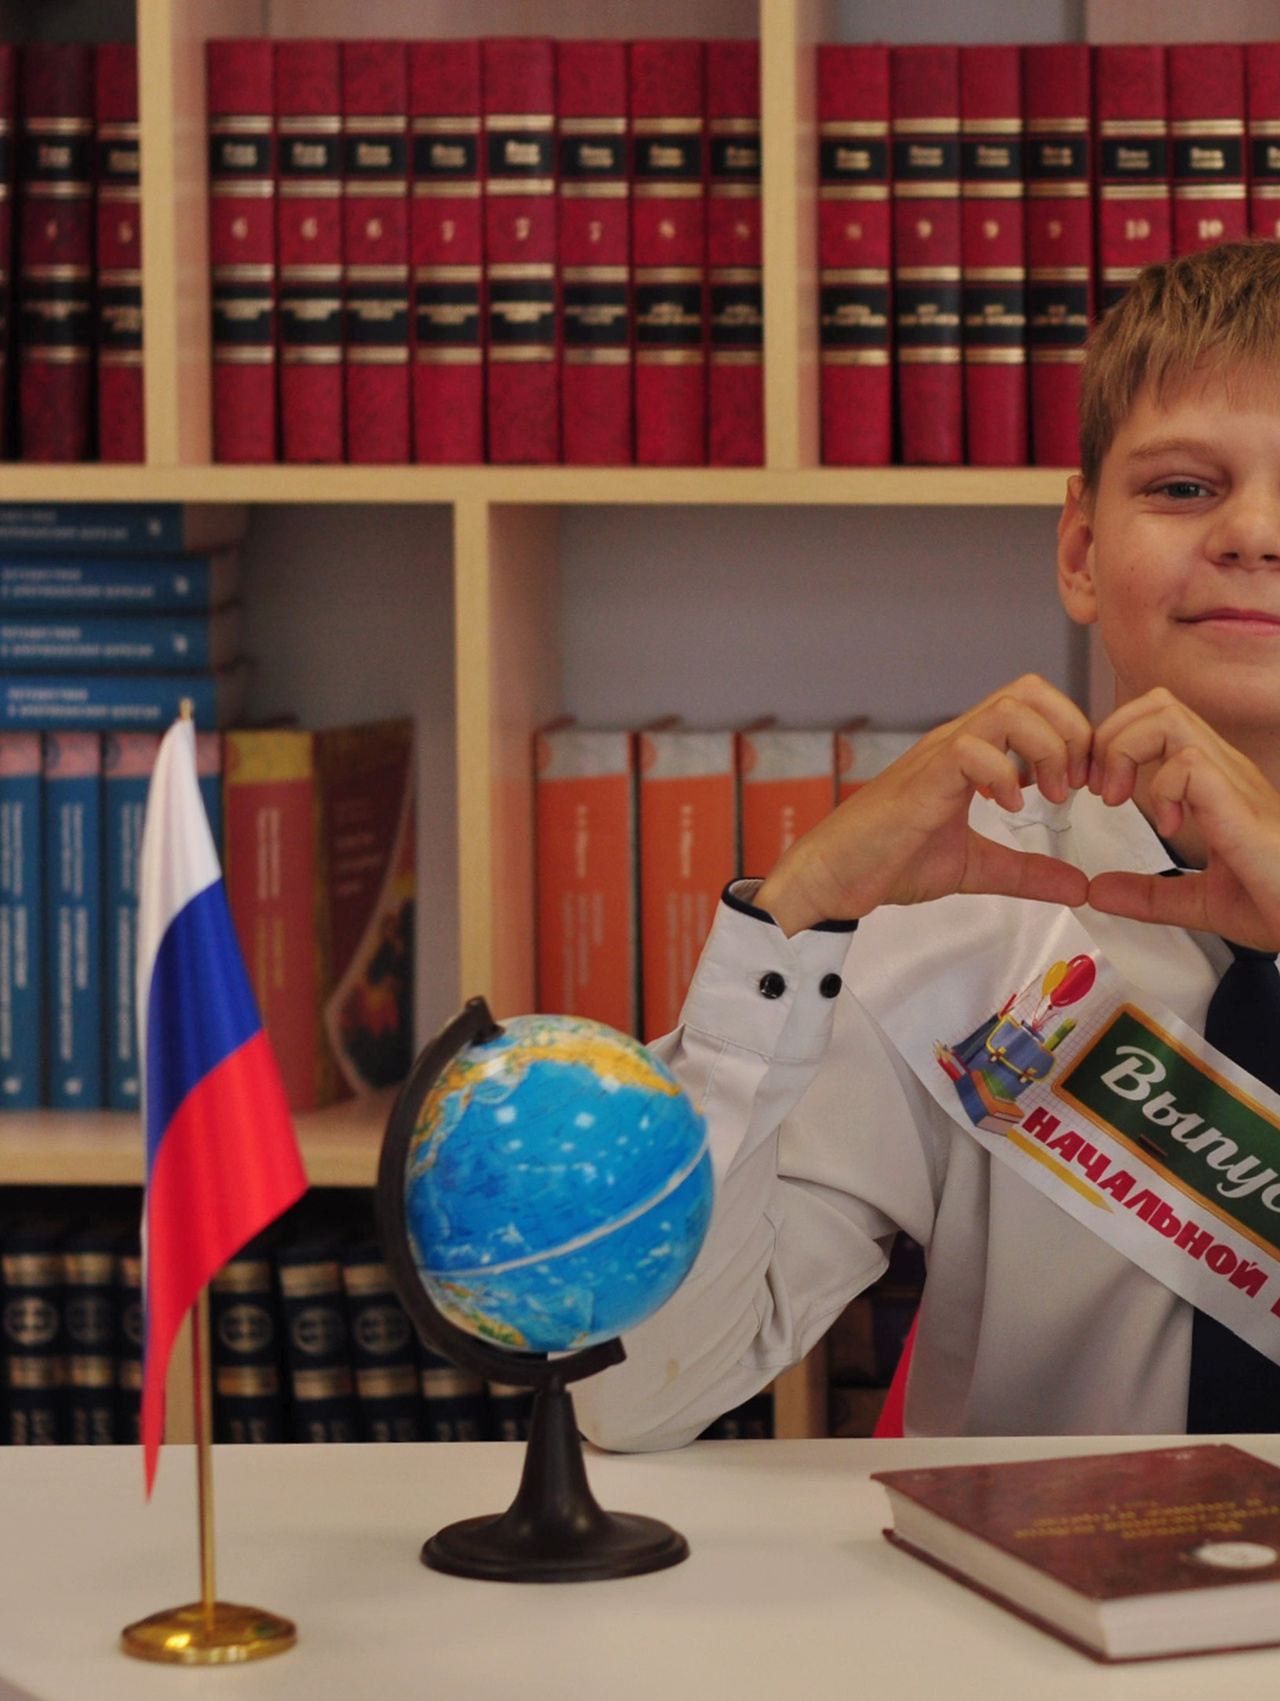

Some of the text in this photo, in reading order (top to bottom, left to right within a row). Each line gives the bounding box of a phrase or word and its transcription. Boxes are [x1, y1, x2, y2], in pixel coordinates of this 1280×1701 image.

[1125, 219, 1151, 240] 10
[1197, 219, 1224, 240] 10
[1021, 1106, 1269, 1299] НАЧАЛЬНОЙ
